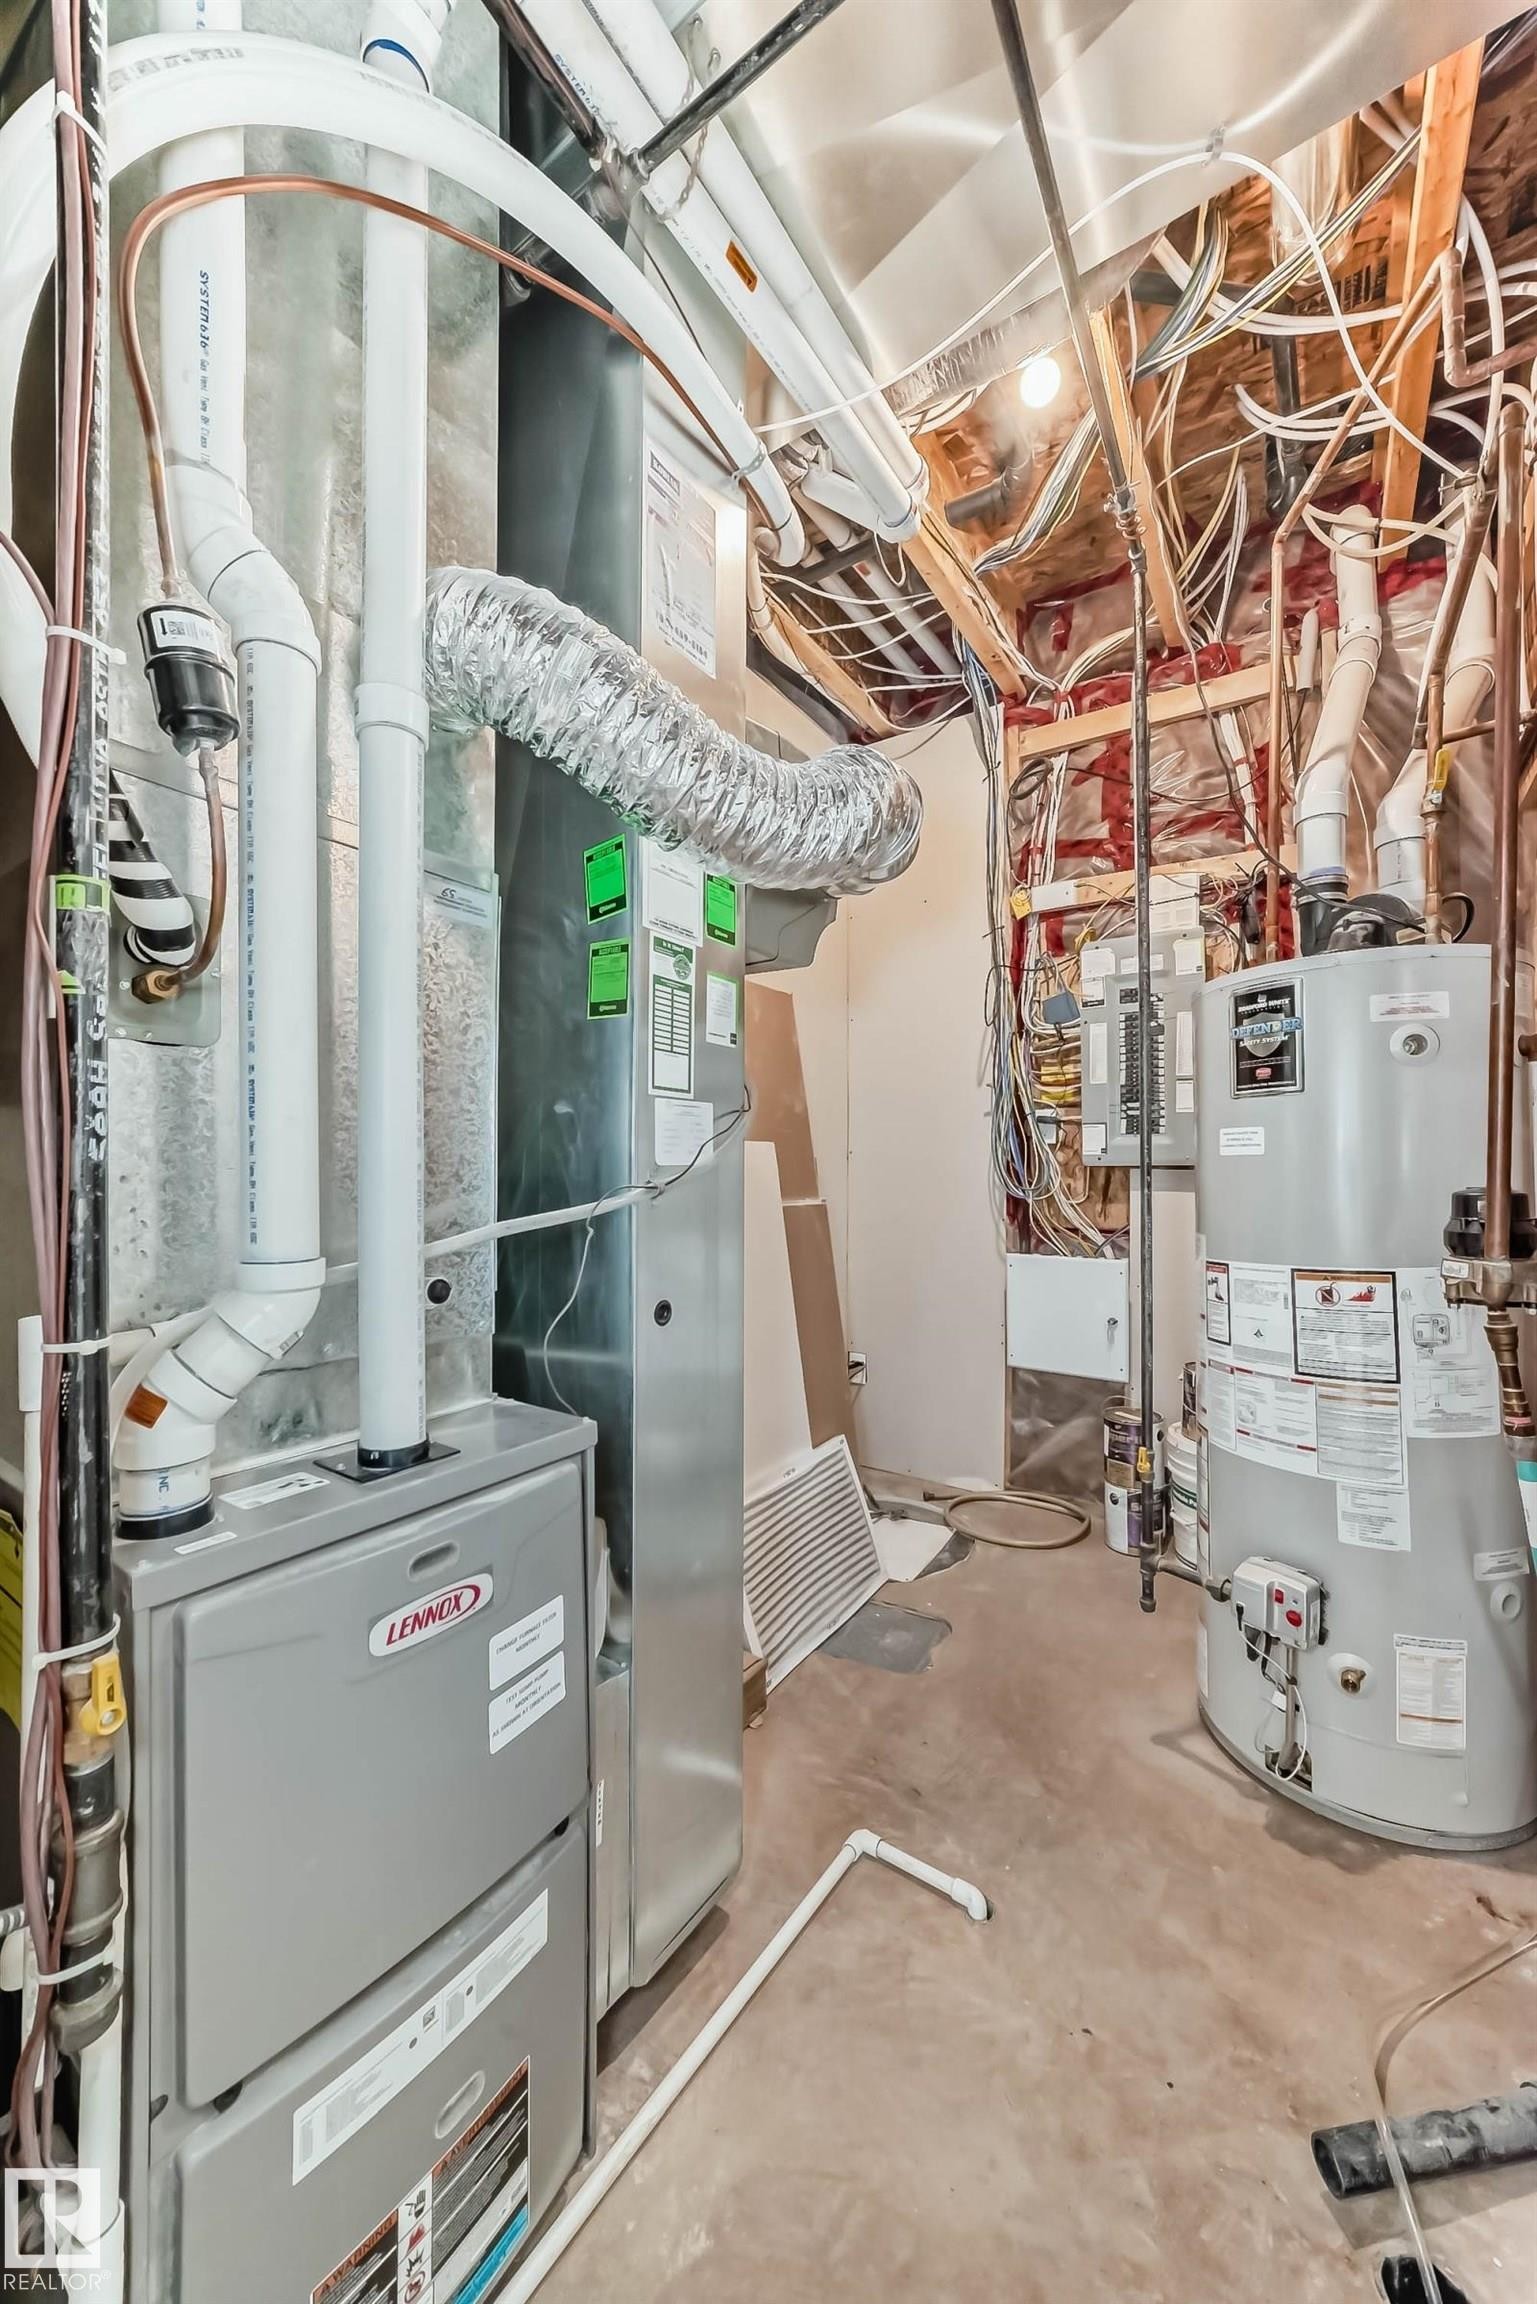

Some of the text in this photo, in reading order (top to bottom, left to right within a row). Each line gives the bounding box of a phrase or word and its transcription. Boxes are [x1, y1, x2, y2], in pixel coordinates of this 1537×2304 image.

[1231, 1017, 1303, 1039] DEFENDER
[386, 1591, 464, 1646] LENNOX
[332, 2218, 395, 2281] WARNING
